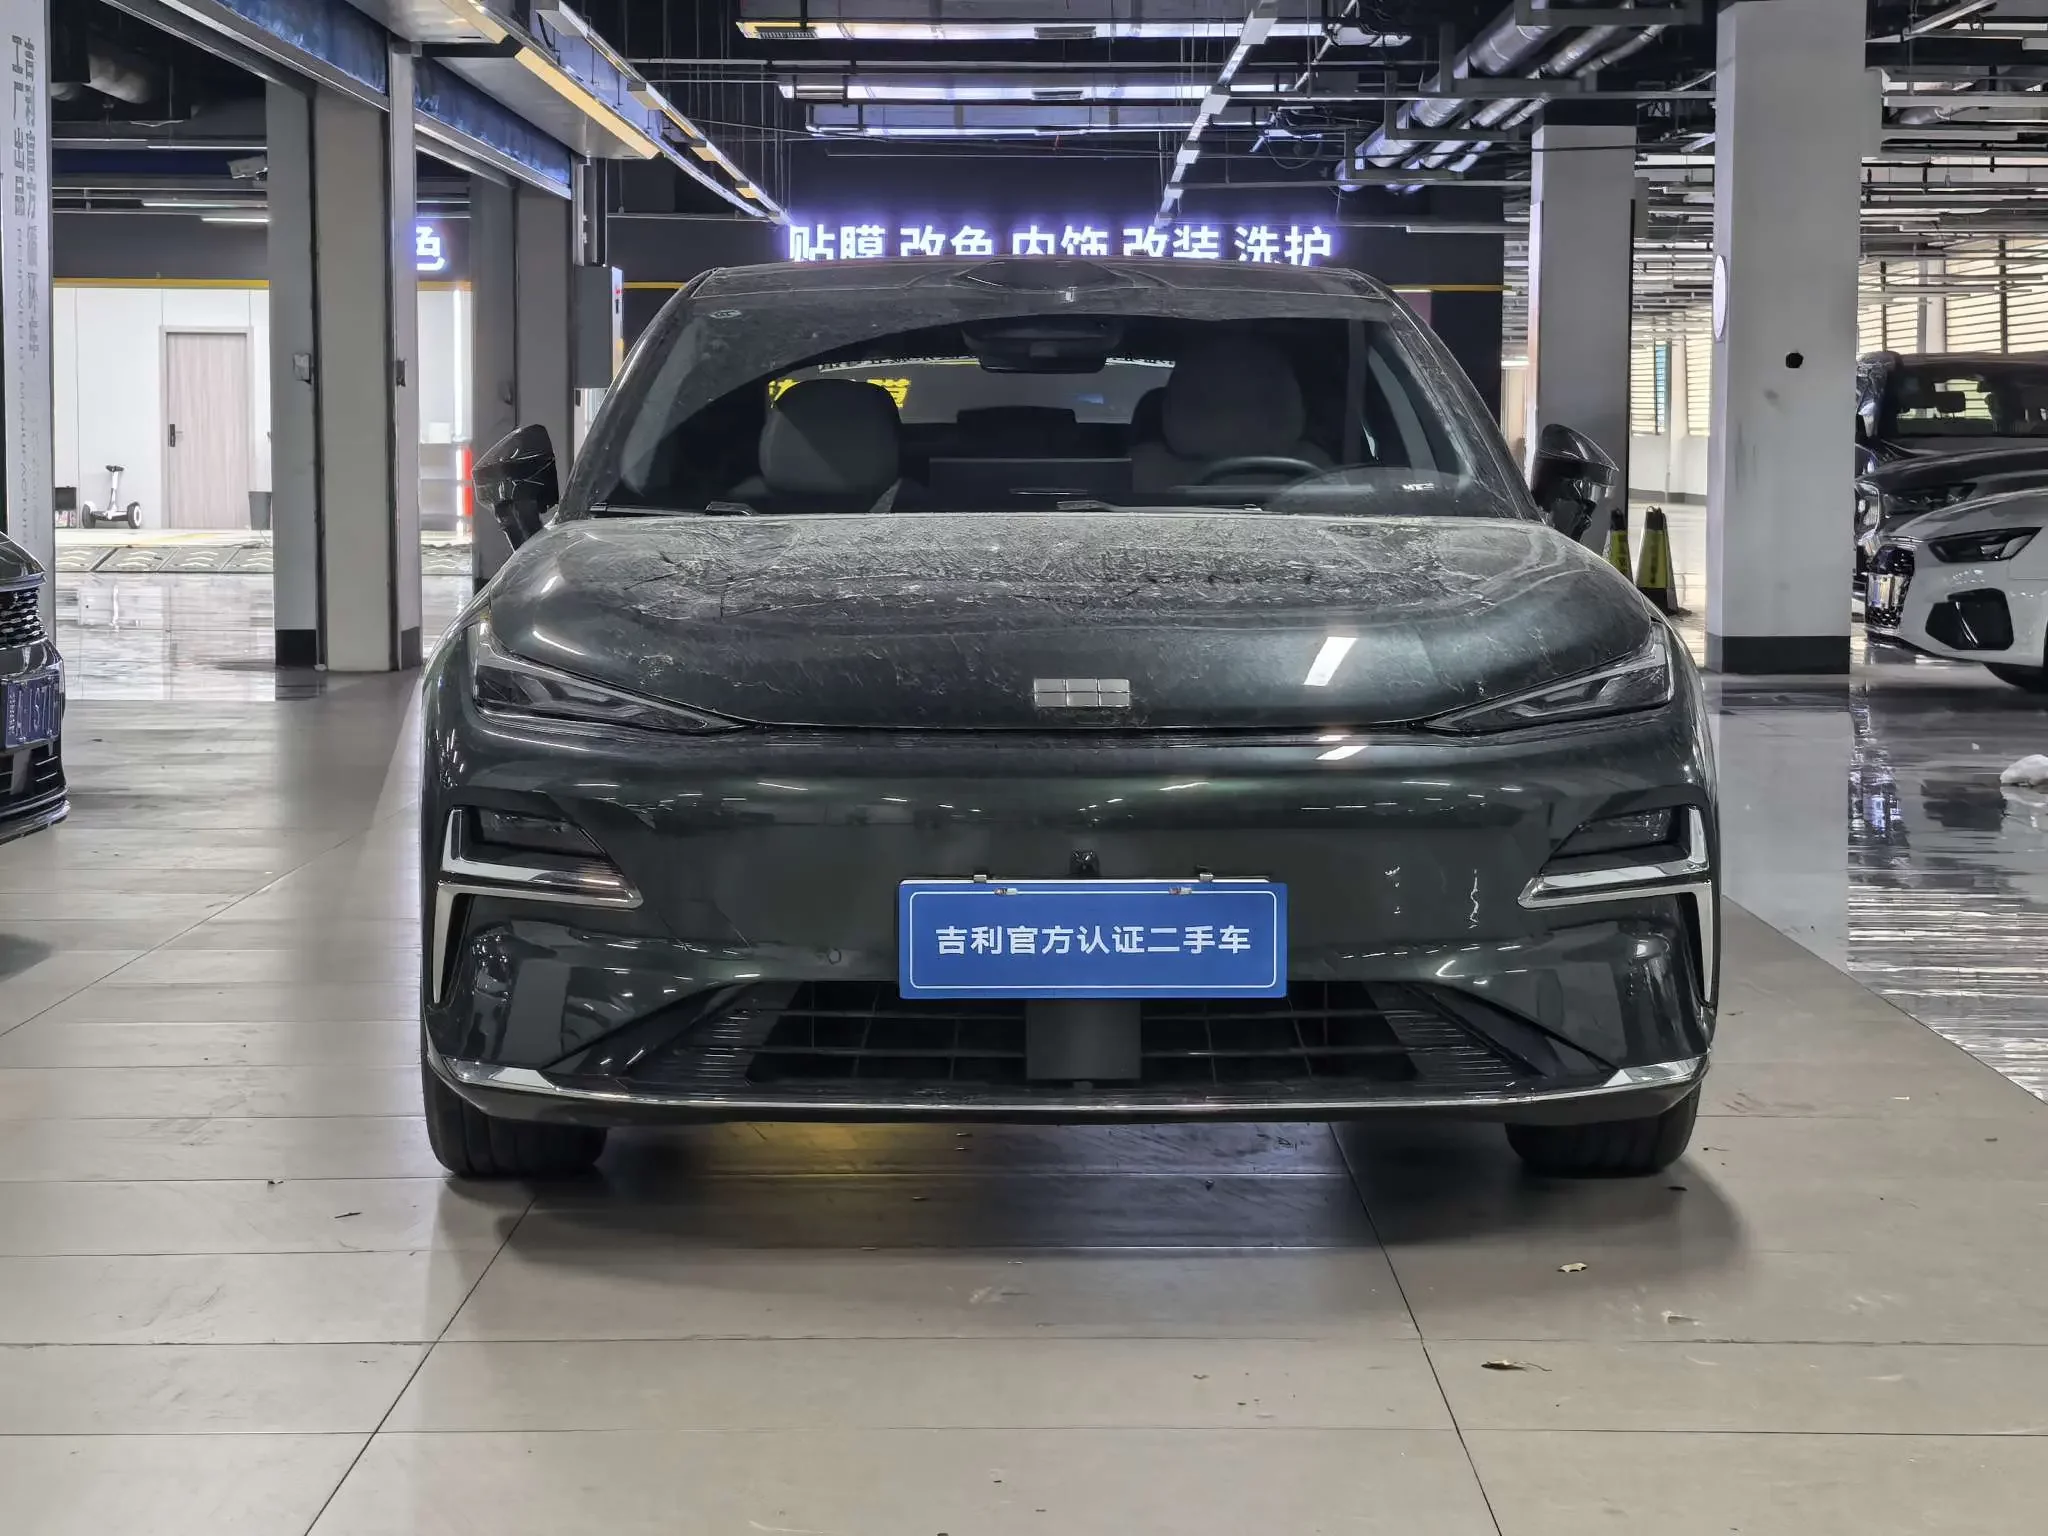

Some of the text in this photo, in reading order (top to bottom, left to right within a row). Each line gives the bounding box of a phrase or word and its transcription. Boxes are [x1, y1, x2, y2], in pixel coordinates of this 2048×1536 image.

[789, 224, 886, 262] 贴膜
[1123, 225, 1219, 258] 改装
[1235, 225, 1332, 266] 洗护
[935, 924, 1252, 955] 吉利官方认证二手车
